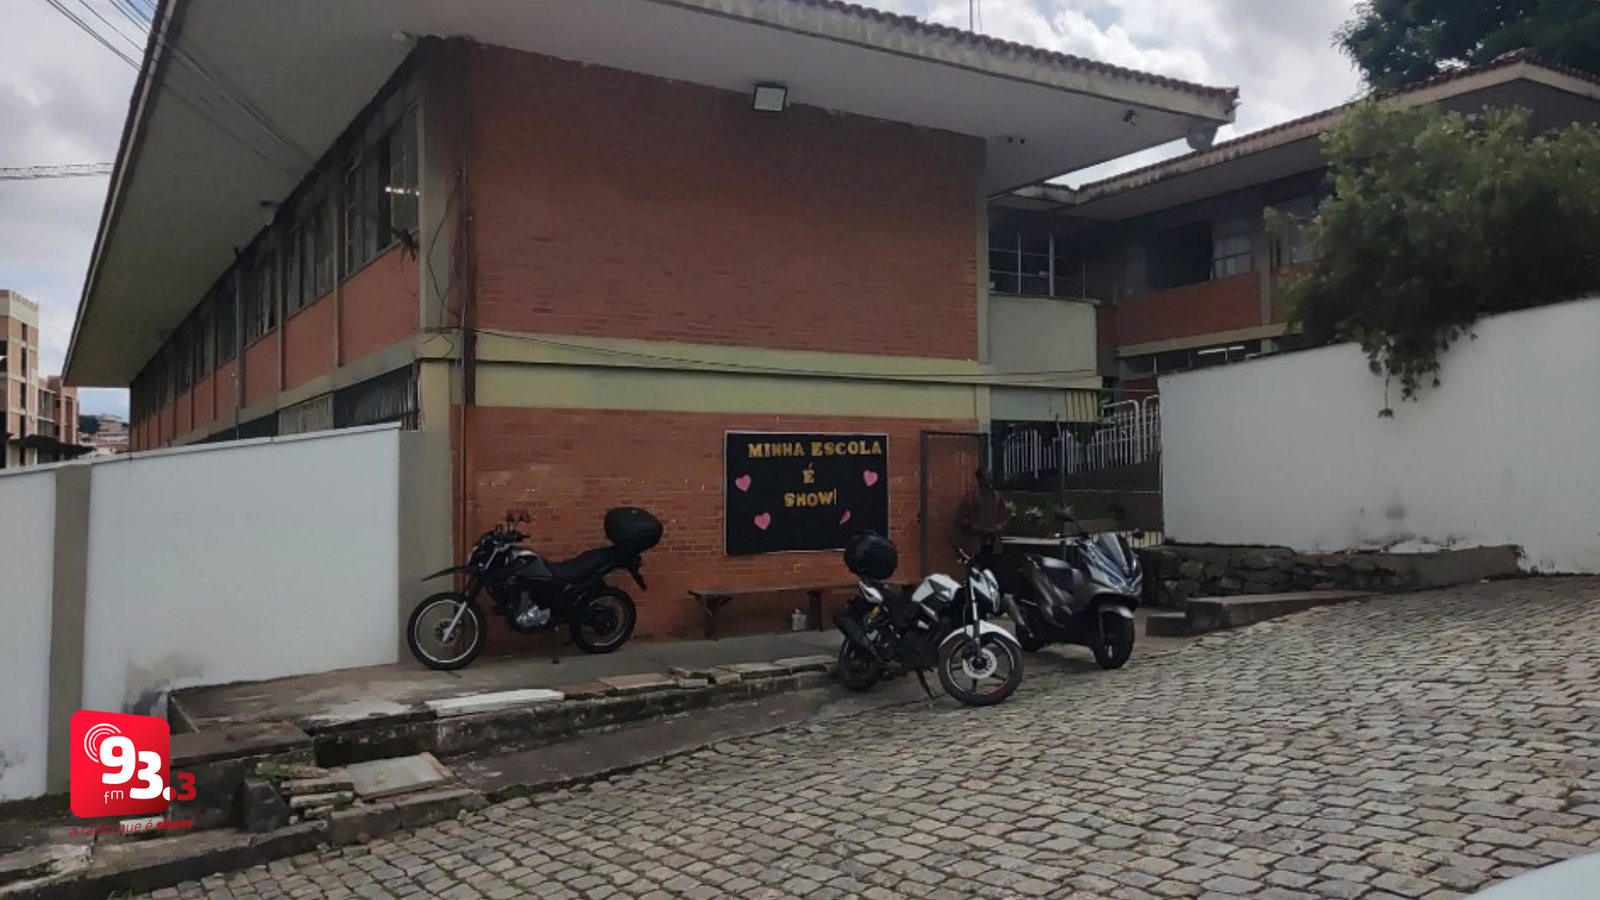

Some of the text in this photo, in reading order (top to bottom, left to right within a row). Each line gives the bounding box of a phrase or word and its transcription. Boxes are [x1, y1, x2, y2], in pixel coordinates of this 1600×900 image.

[748, 440, 882, 458] MINHA ESCOLA
[803, 462, 815, 483] É
